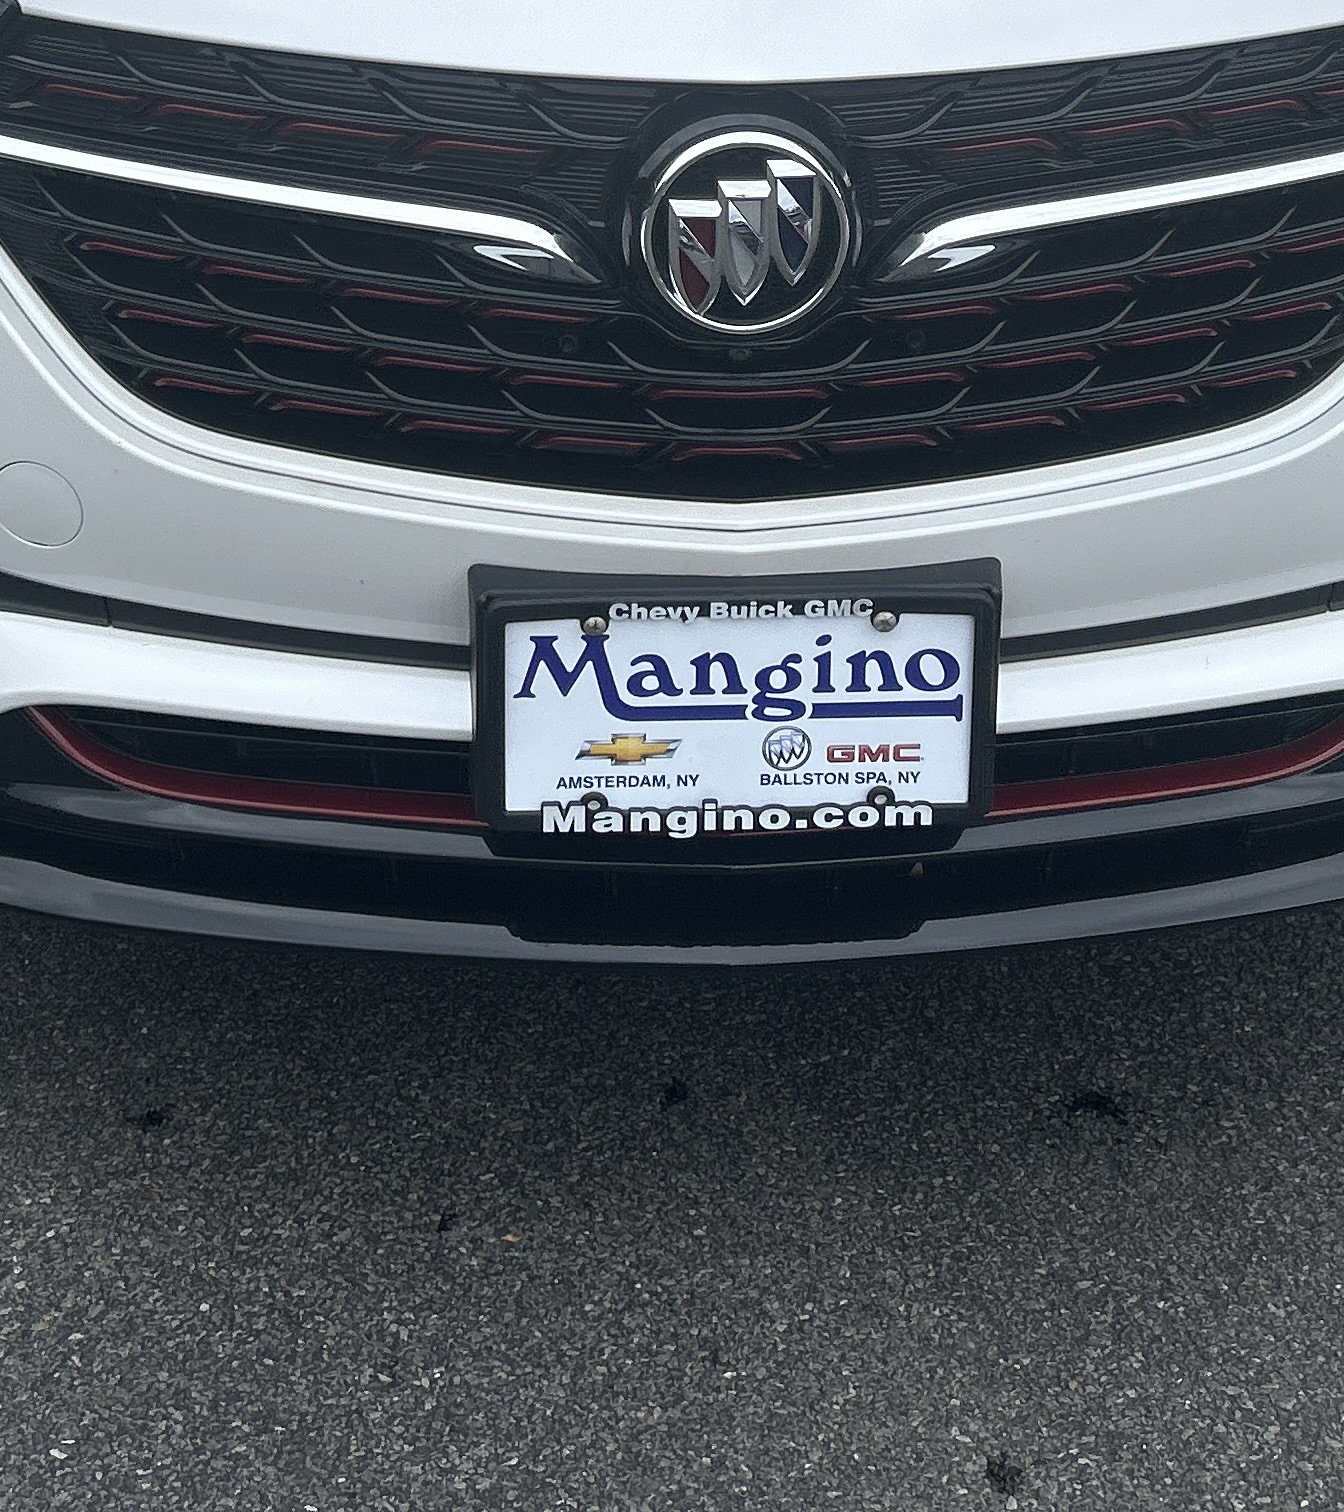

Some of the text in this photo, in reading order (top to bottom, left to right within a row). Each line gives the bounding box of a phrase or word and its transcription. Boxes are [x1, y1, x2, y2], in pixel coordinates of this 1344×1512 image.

[609, 598, 874, 624] Chevy Buick GMC
[513, 634, 962, 722] Mangino
[826, 743, 921, 763] GMC
[556, 774, 700, 790] AMSTERDAM, NY
[760, 771, 921, 786] BALLSTON SPA, NY
[541, 801, 934, 839] Mangino.com
